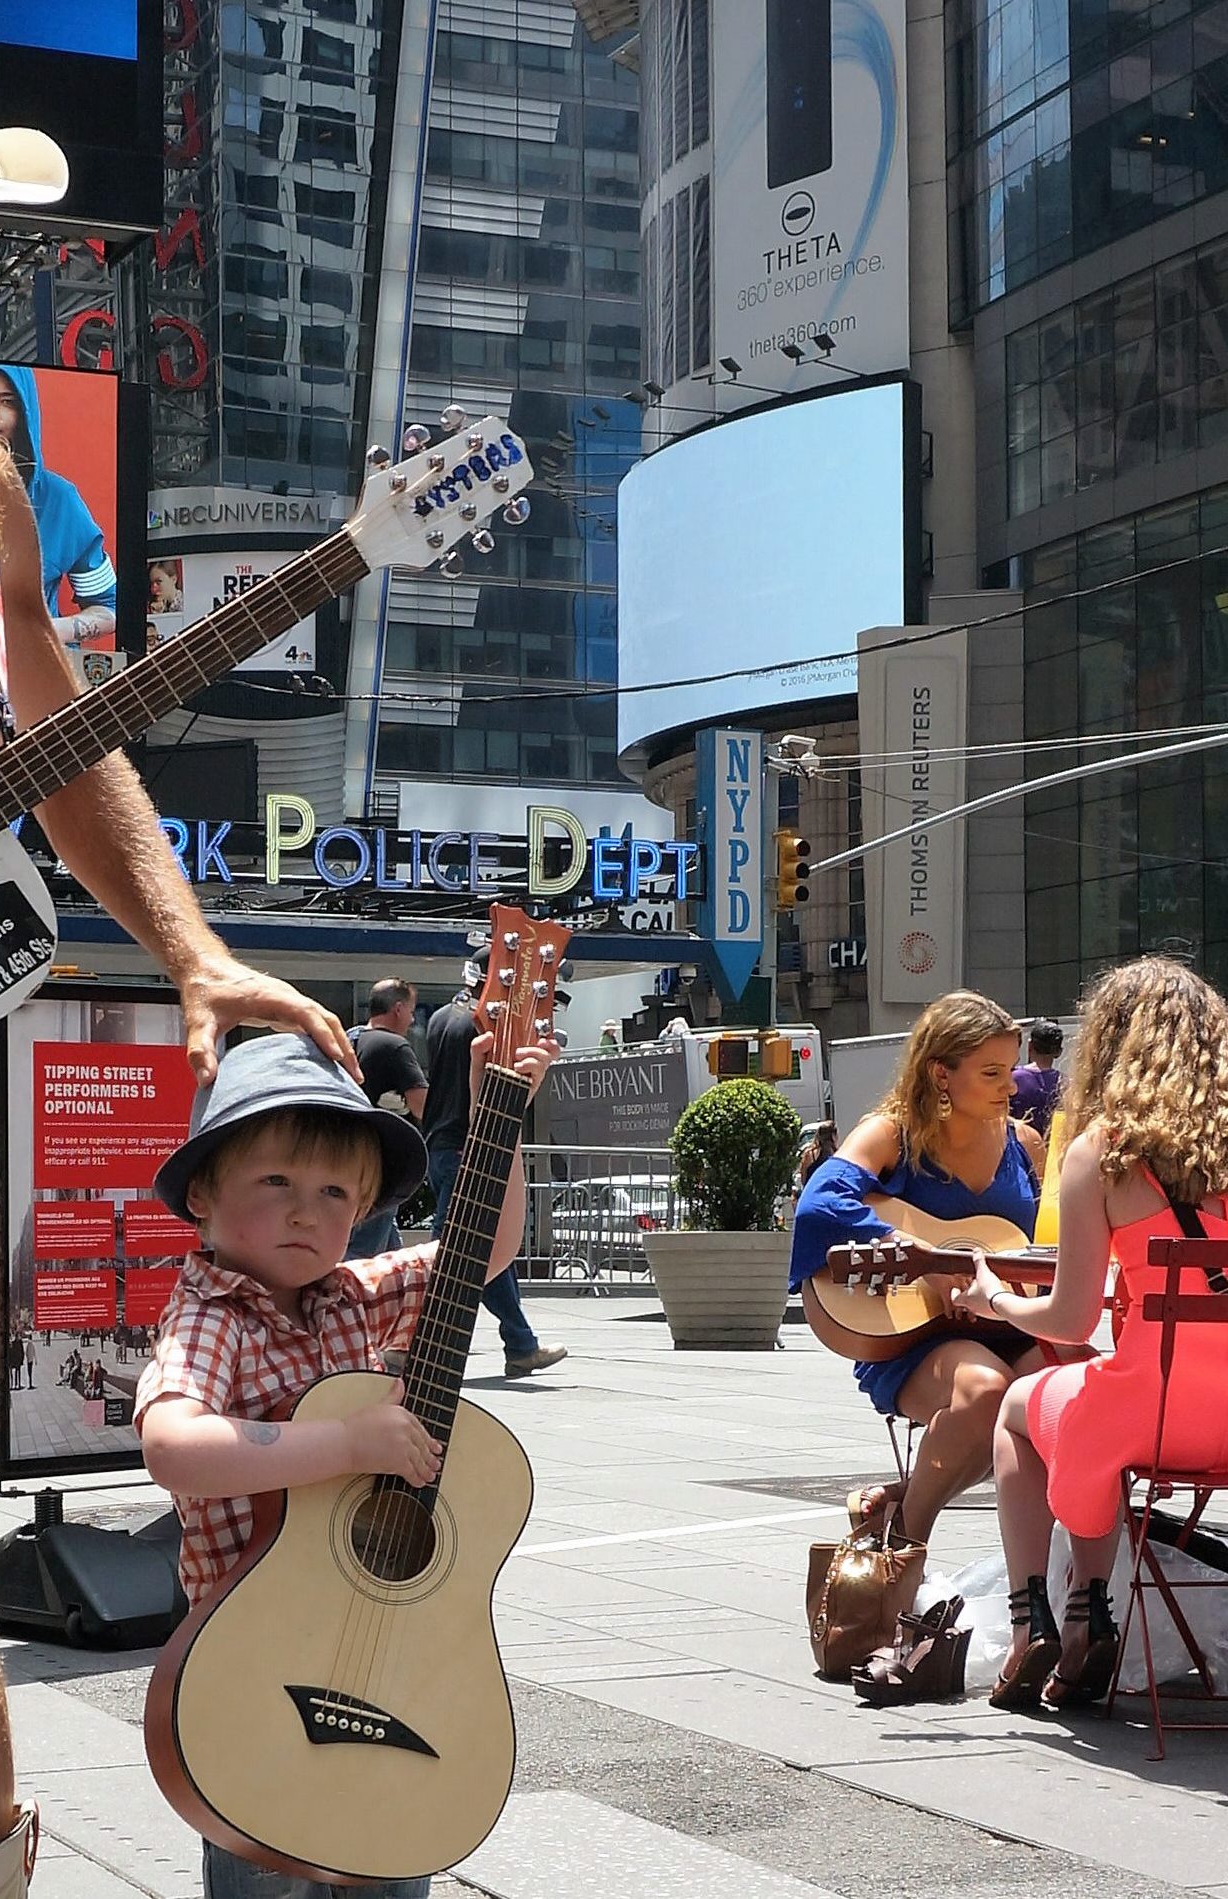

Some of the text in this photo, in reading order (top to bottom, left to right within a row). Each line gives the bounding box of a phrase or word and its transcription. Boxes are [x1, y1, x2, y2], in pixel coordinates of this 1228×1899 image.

[762, 232, 841, 274] THETA
[749, 316, 856, 358] theta360com
[164, 502, 326, 528] NBCUNIVERSAL
[235, 565, 252, 574] THE
[285, 645, 298, 660] 4
[910, 686, 931, 916] THOMSON REUTERS
[726, 738, 750, 934] NYPD
[266, 794, 500, 890] POLICE
[527, 804, 699, 900] DEPT
[7, 950, 37, 985] 45th
[44, 1065, 153, 1081] TIPPING STREET
[590, 1063, 668, 1099] BRYANT
[44, 1083, 156, 1098] PERFORMERS IS
[44, 1100, 114, 1115] OPTIONAL
[51, 1137, 64, 1145] you
[88, 1137, 126, 1145] experience
[141, 1137, 176, 1146] aggressive
[124, 1147, 150, 1155] contact
[44, 1157, 67, 1165] officer
[77, 1157, 91, 1165] call
